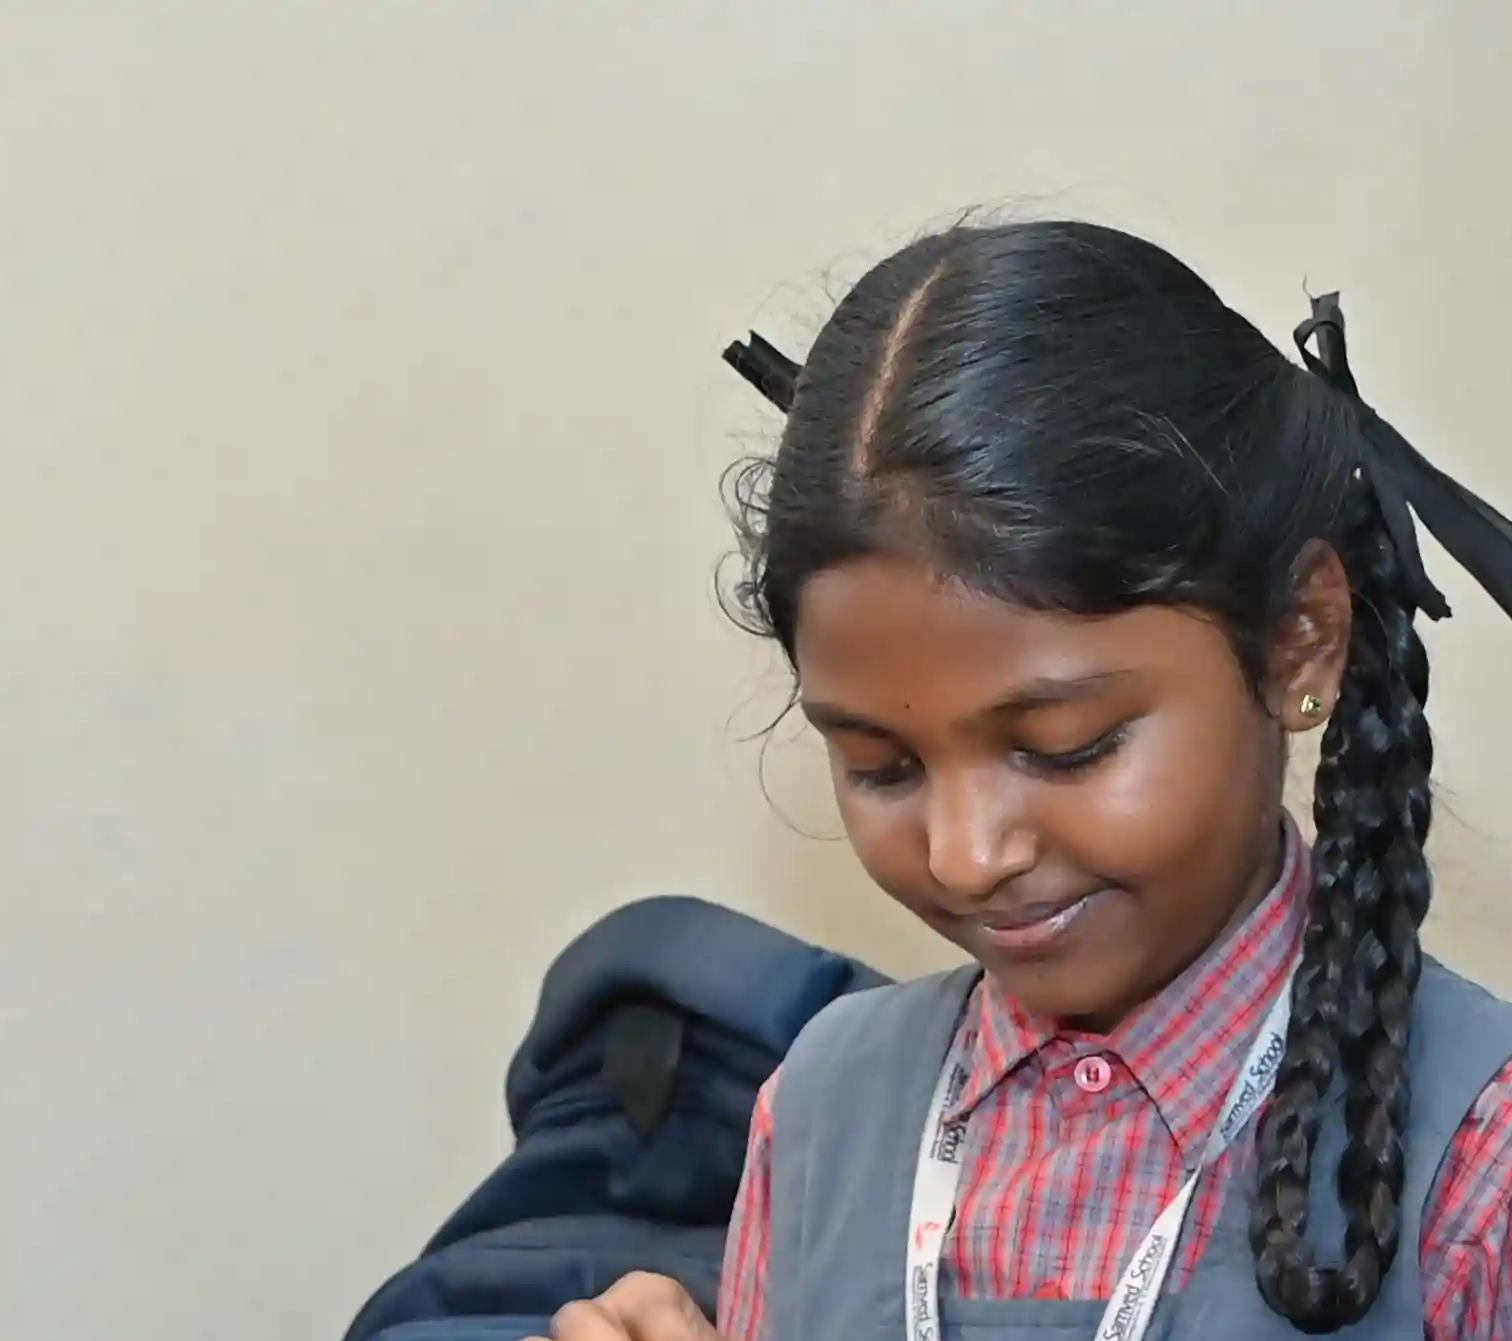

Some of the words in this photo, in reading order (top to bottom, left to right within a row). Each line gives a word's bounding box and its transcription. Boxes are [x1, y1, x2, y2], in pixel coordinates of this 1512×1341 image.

[1248, 1031, 1285, 1077] School
[1130, 1232, 1164, 1283] School
[920, 1262, 932, 1321] Samved
